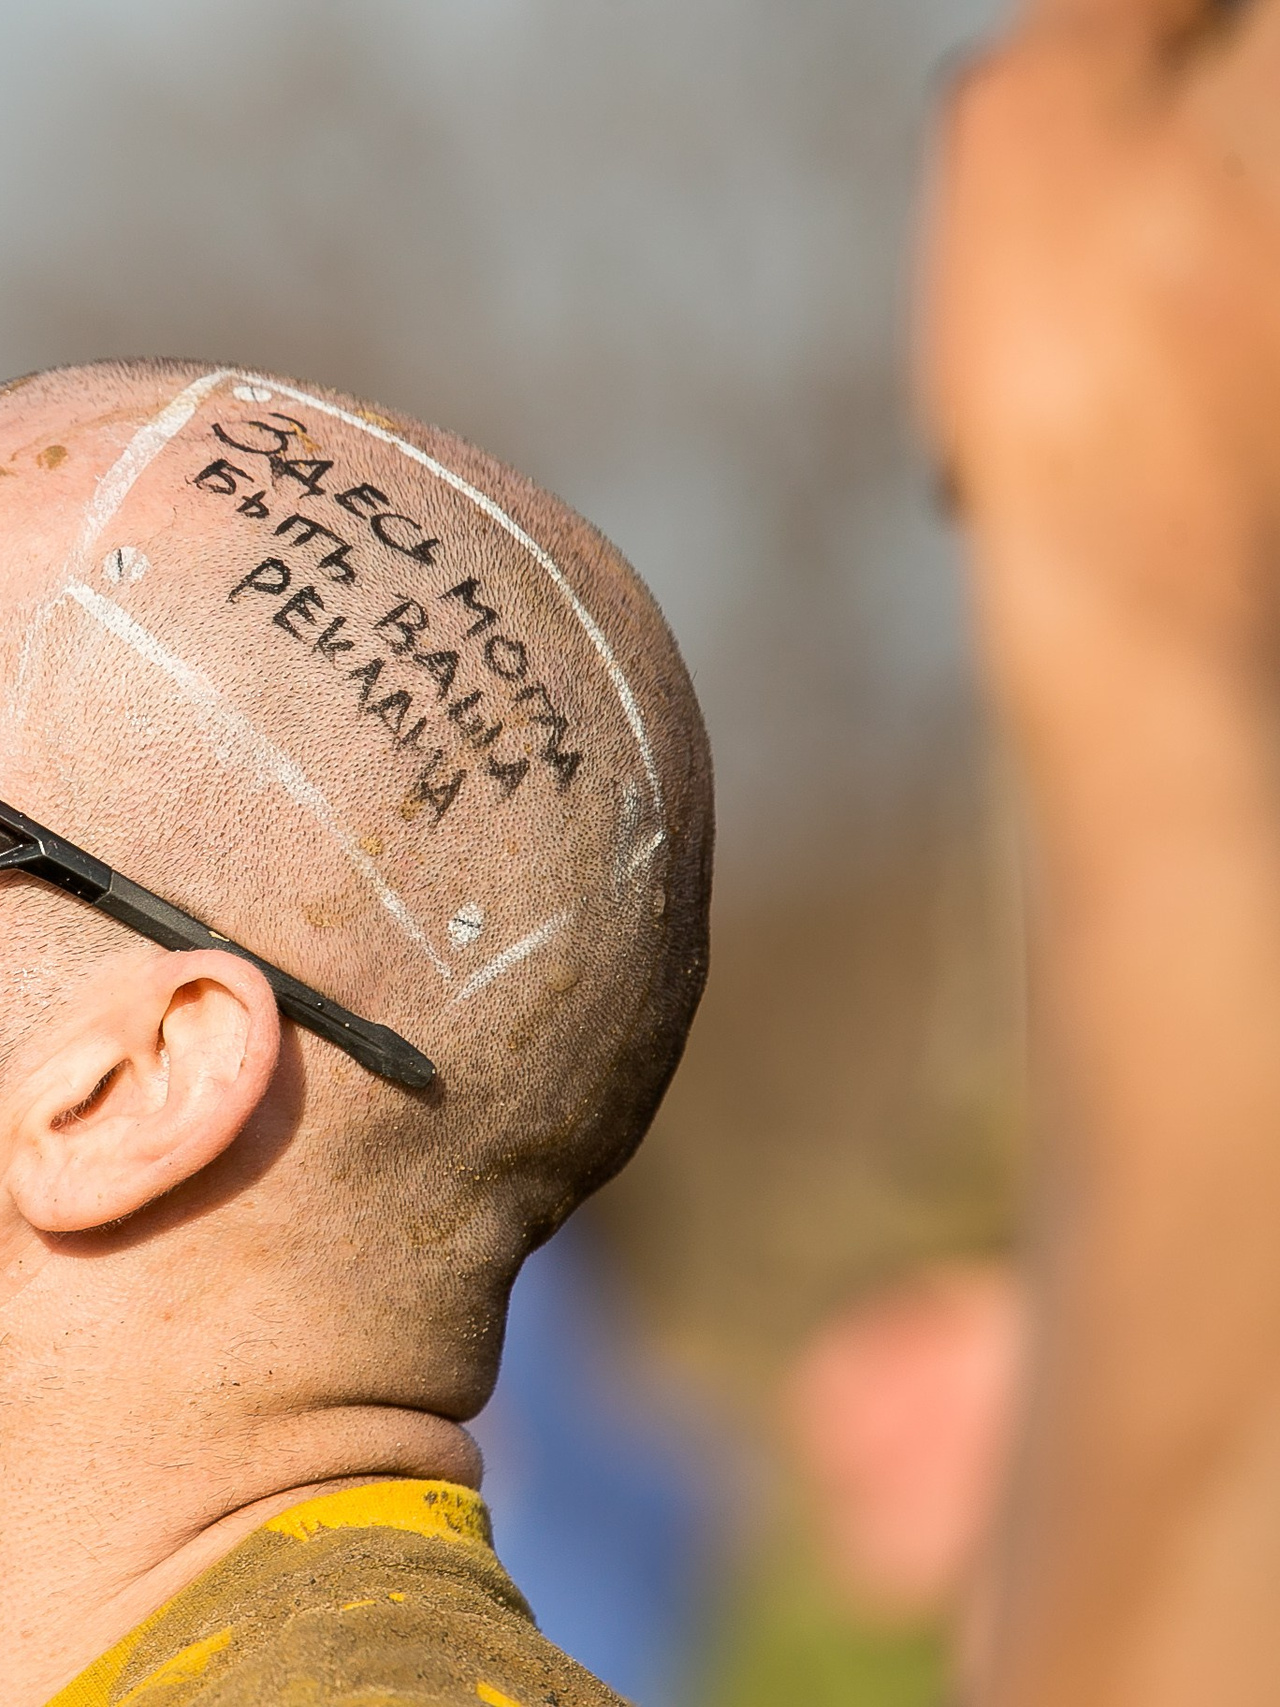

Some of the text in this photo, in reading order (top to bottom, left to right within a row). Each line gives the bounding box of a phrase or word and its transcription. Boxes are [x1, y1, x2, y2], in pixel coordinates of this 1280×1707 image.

[213, 412, 441, 566] ЗДЕСЬ
[226, 556, 468, 824] РЕКЛАМА
[373, 593, 531, 797] ВАША
